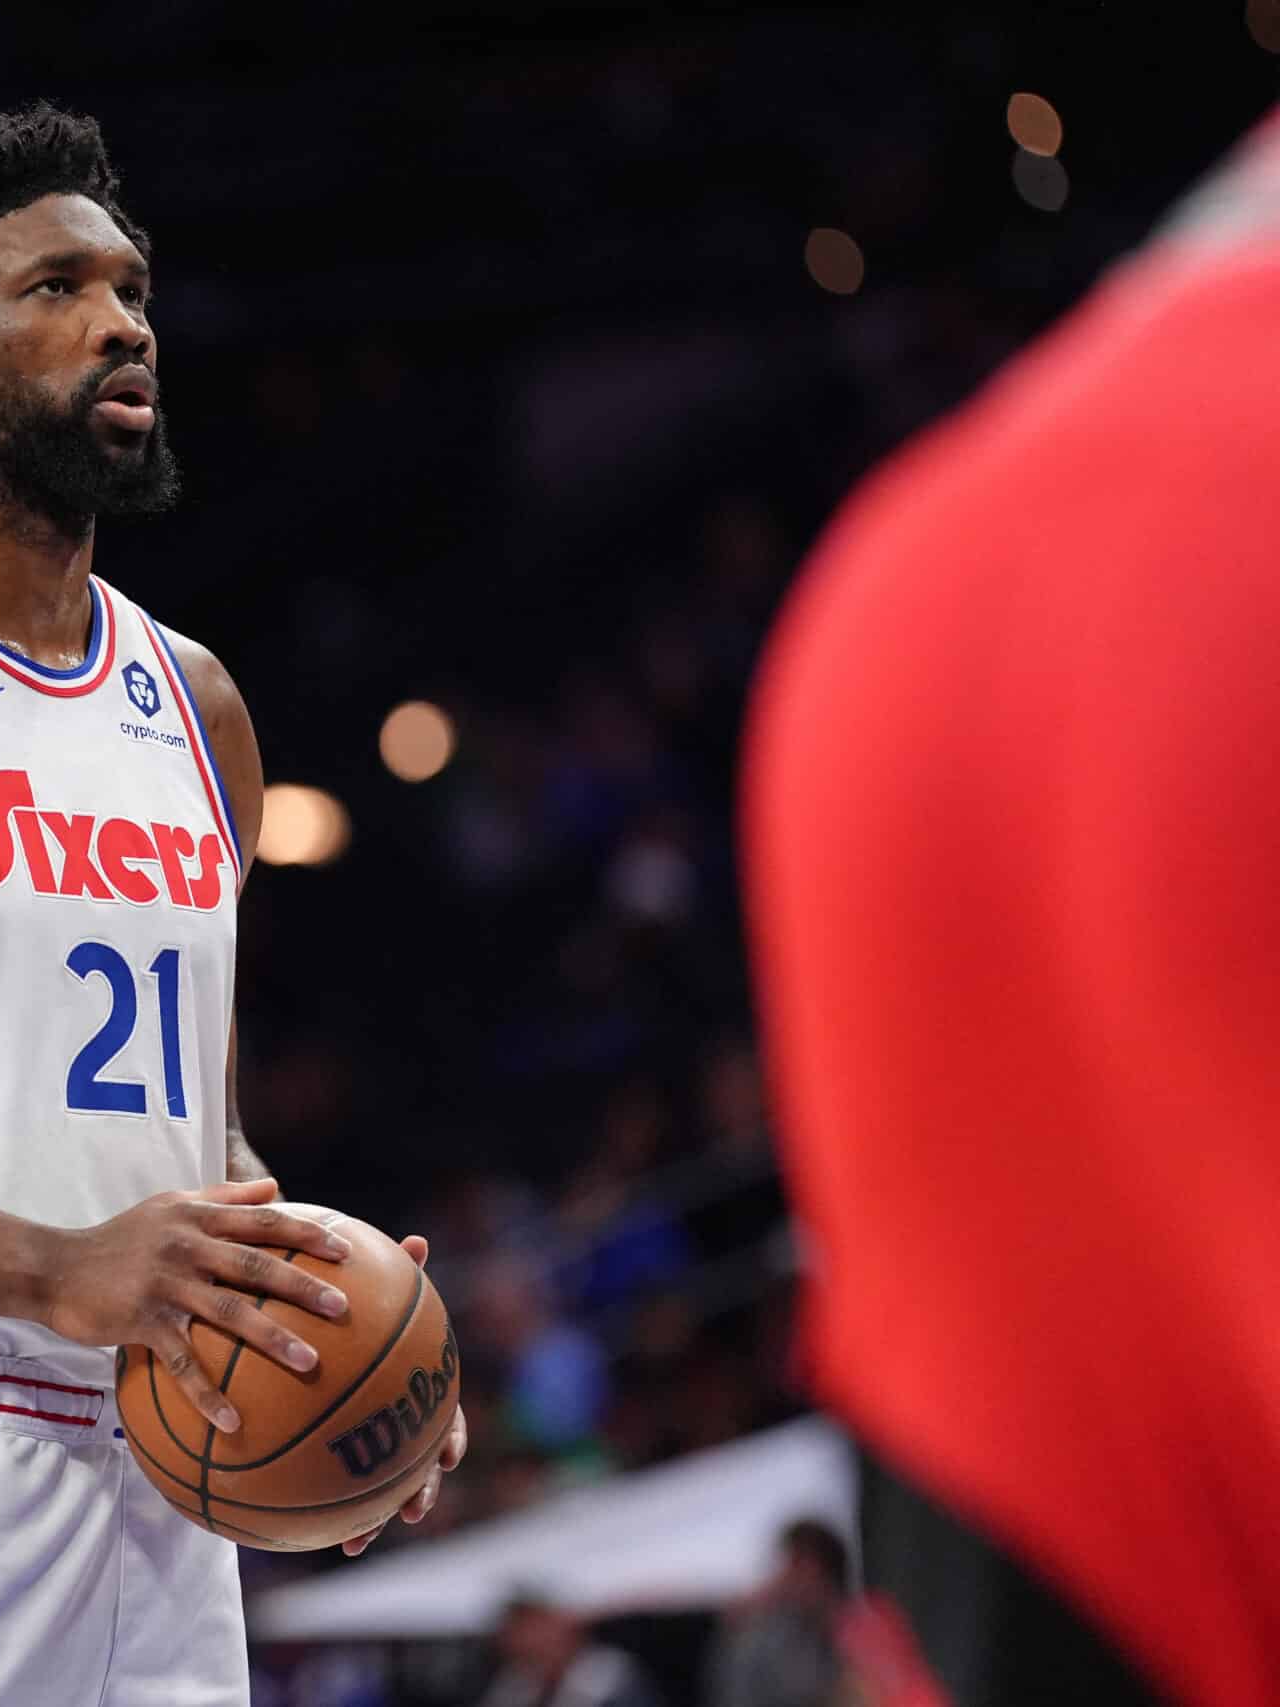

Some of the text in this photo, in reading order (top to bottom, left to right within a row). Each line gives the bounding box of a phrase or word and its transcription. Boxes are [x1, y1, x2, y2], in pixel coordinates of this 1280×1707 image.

[120, 722, 186, 749] crypto.com
[65, 941, 190, 1121] 21
[327, 1322, 459, 1478] Wilso
